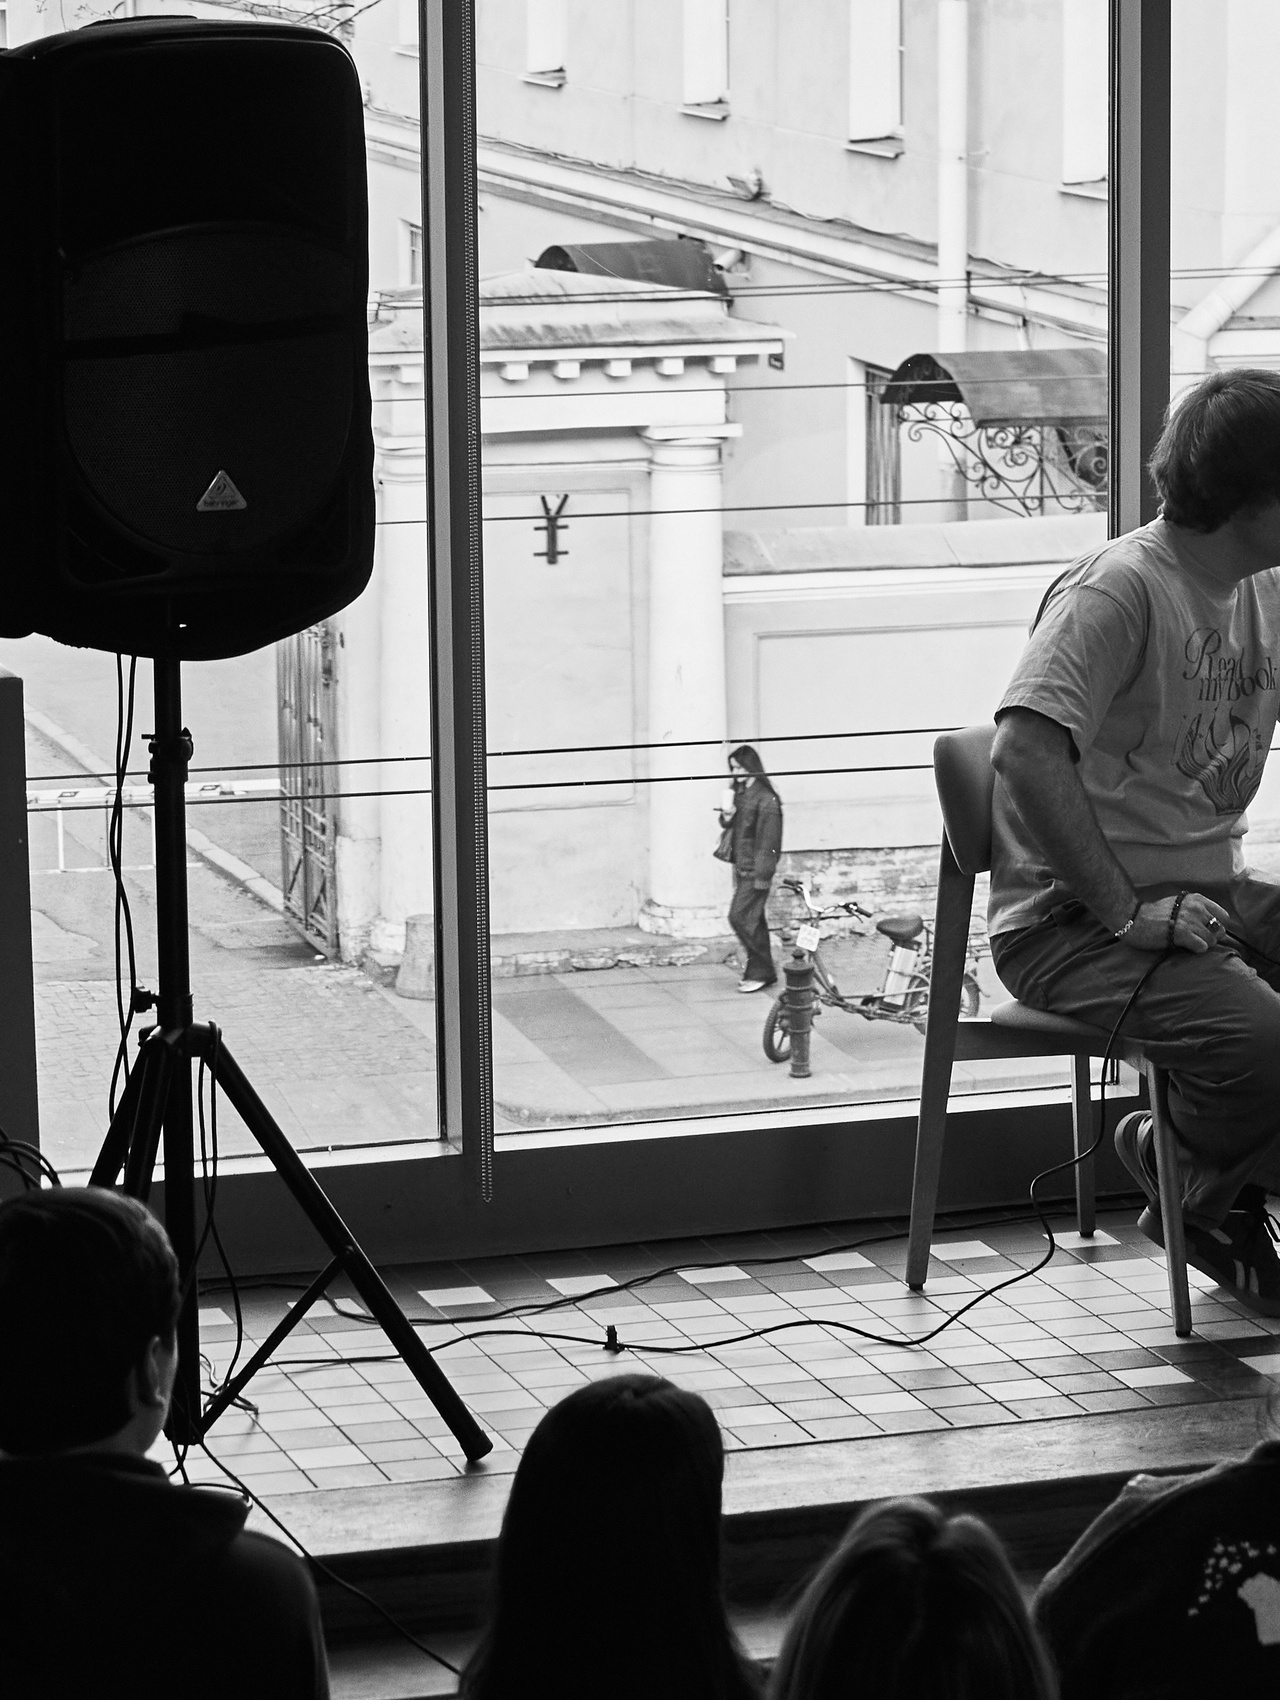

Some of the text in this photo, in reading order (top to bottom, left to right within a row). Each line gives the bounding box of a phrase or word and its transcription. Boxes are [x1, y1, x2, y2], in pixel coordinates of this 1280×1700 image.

[1182, 627, 1245, 682] Read
[1198, 657, 1277, 703] my book
